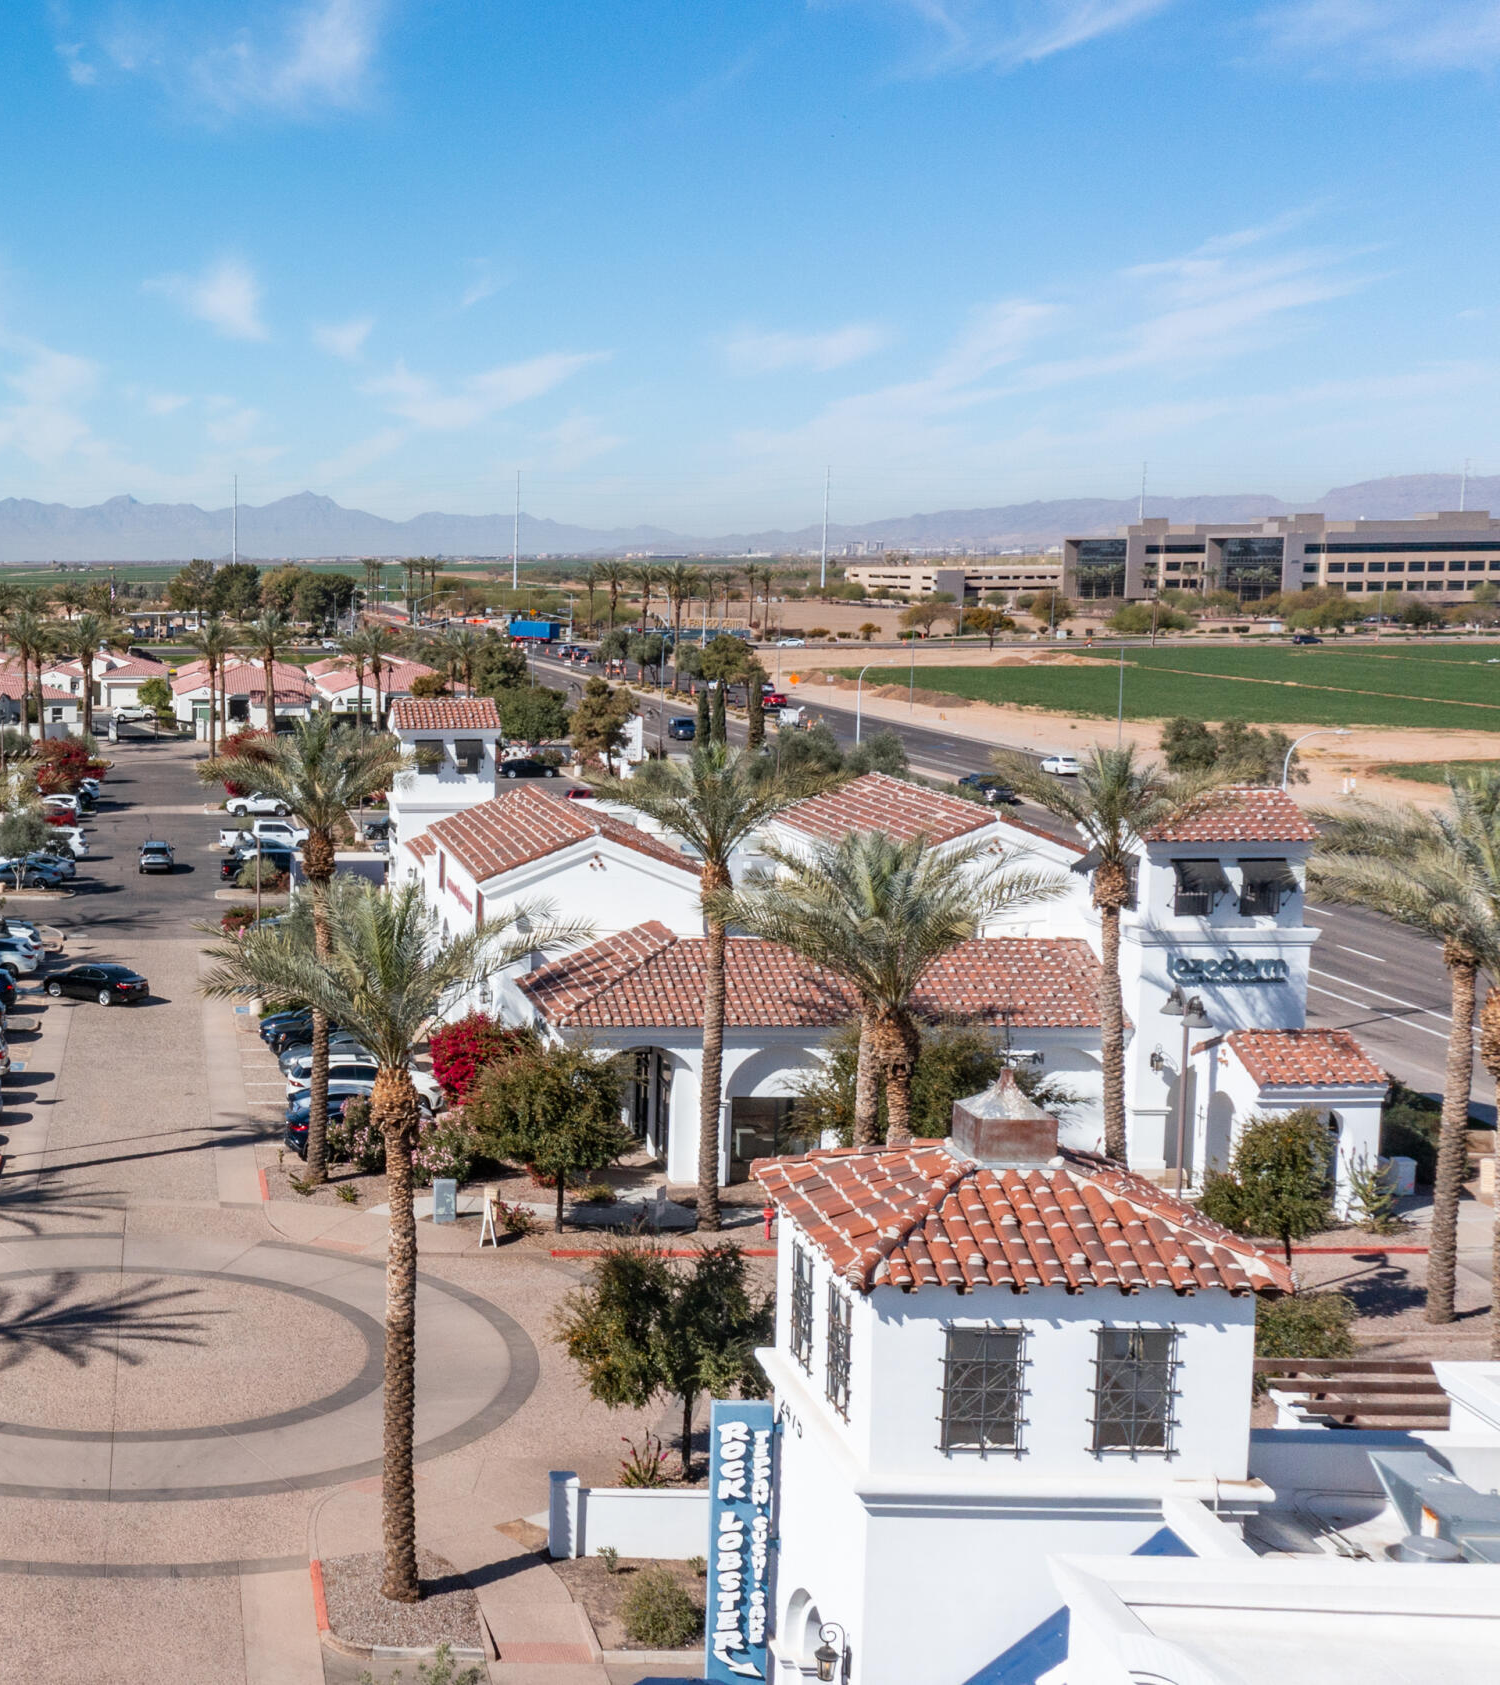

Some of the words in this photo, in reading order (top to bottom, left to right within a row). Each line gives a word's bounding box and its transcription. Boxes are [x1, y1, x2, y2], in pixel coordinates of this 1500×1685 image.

[717, 1421, 750, 1500] ROCK
[751, 1429, 772, 1506] TEPPAN
[713, 1511, 746, 1650] LOBSTER
[751, 1515, 768, 1581] SUSHI
[748, 1590, 767, 1644] SAKE
